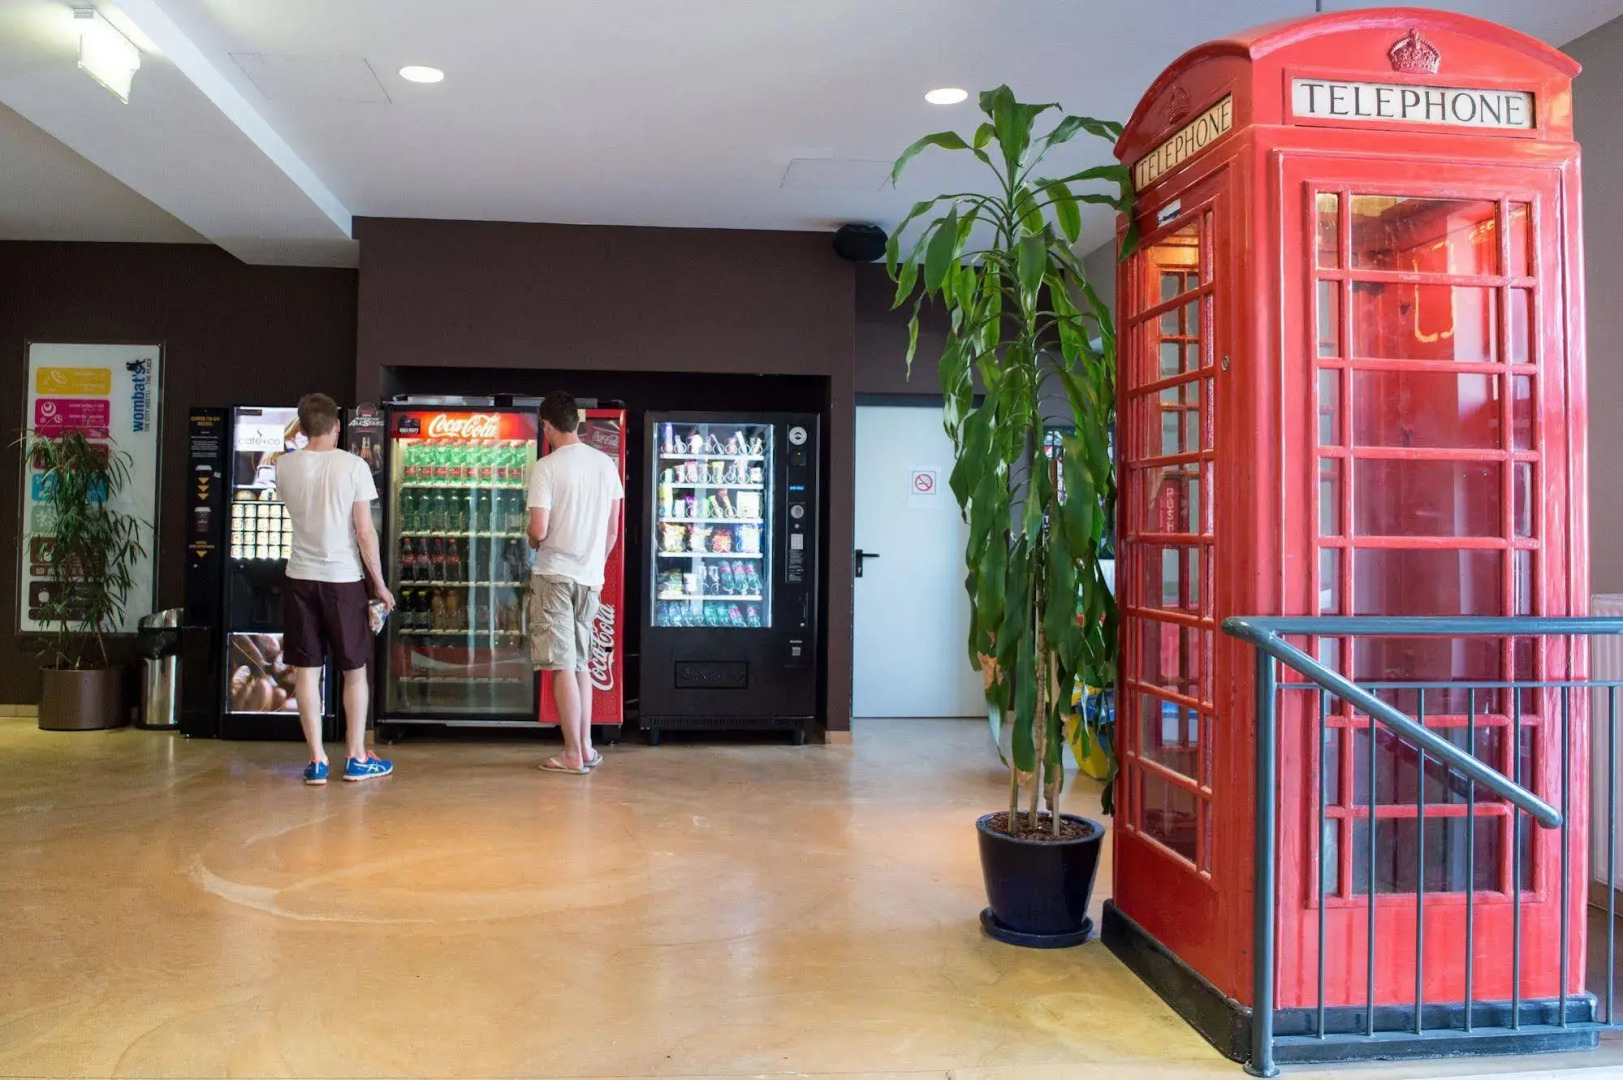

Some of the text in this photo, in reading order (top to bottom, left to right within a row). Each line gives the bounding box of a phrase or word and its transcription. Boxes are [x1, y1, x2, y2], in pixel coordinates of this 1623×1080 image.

[1300, 84, 1524, 125] TELEPHONE
[1138, 100, 1231, 187] TELEPHONE
[131, 365, 146, 433] wombat's
[428, 413, 501, 438] Coca-Cola
